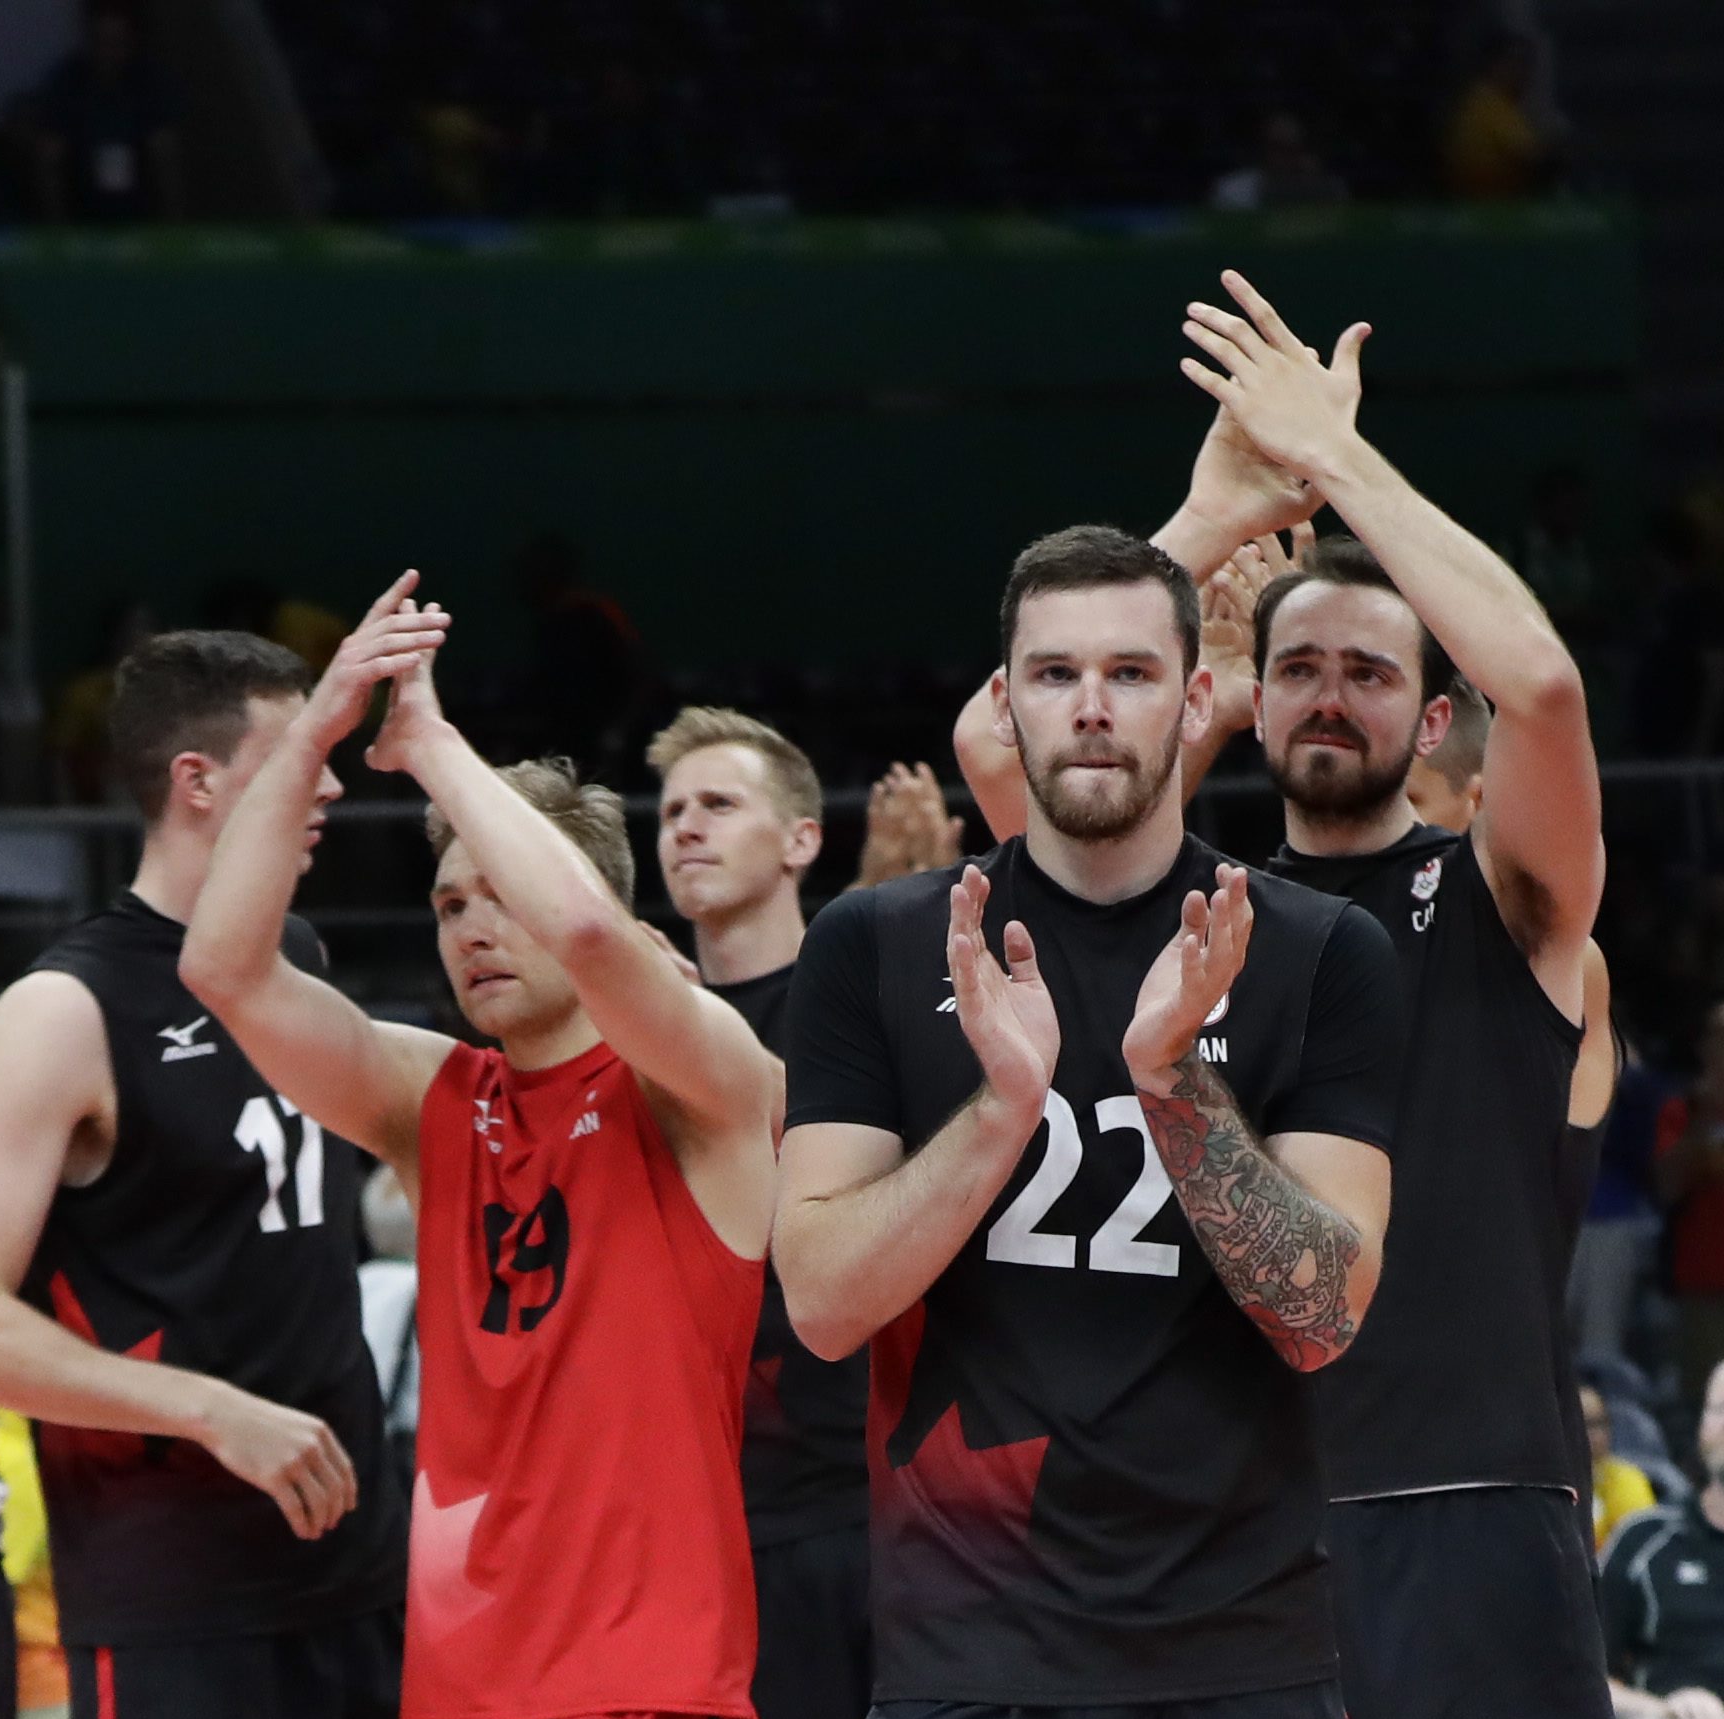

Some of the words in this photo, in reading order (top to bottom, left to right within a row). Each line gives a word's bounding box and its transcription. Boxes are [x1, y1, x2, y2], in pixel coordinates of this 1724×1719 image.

[1198, 1037, 1228, 1063] AN
[233, 1096, 324, 1233] 17
[569, 1111, 601, 1141] AN
[986, 1087, 1180, 1277] 22
[479, 1184, 570, 1334] 19
